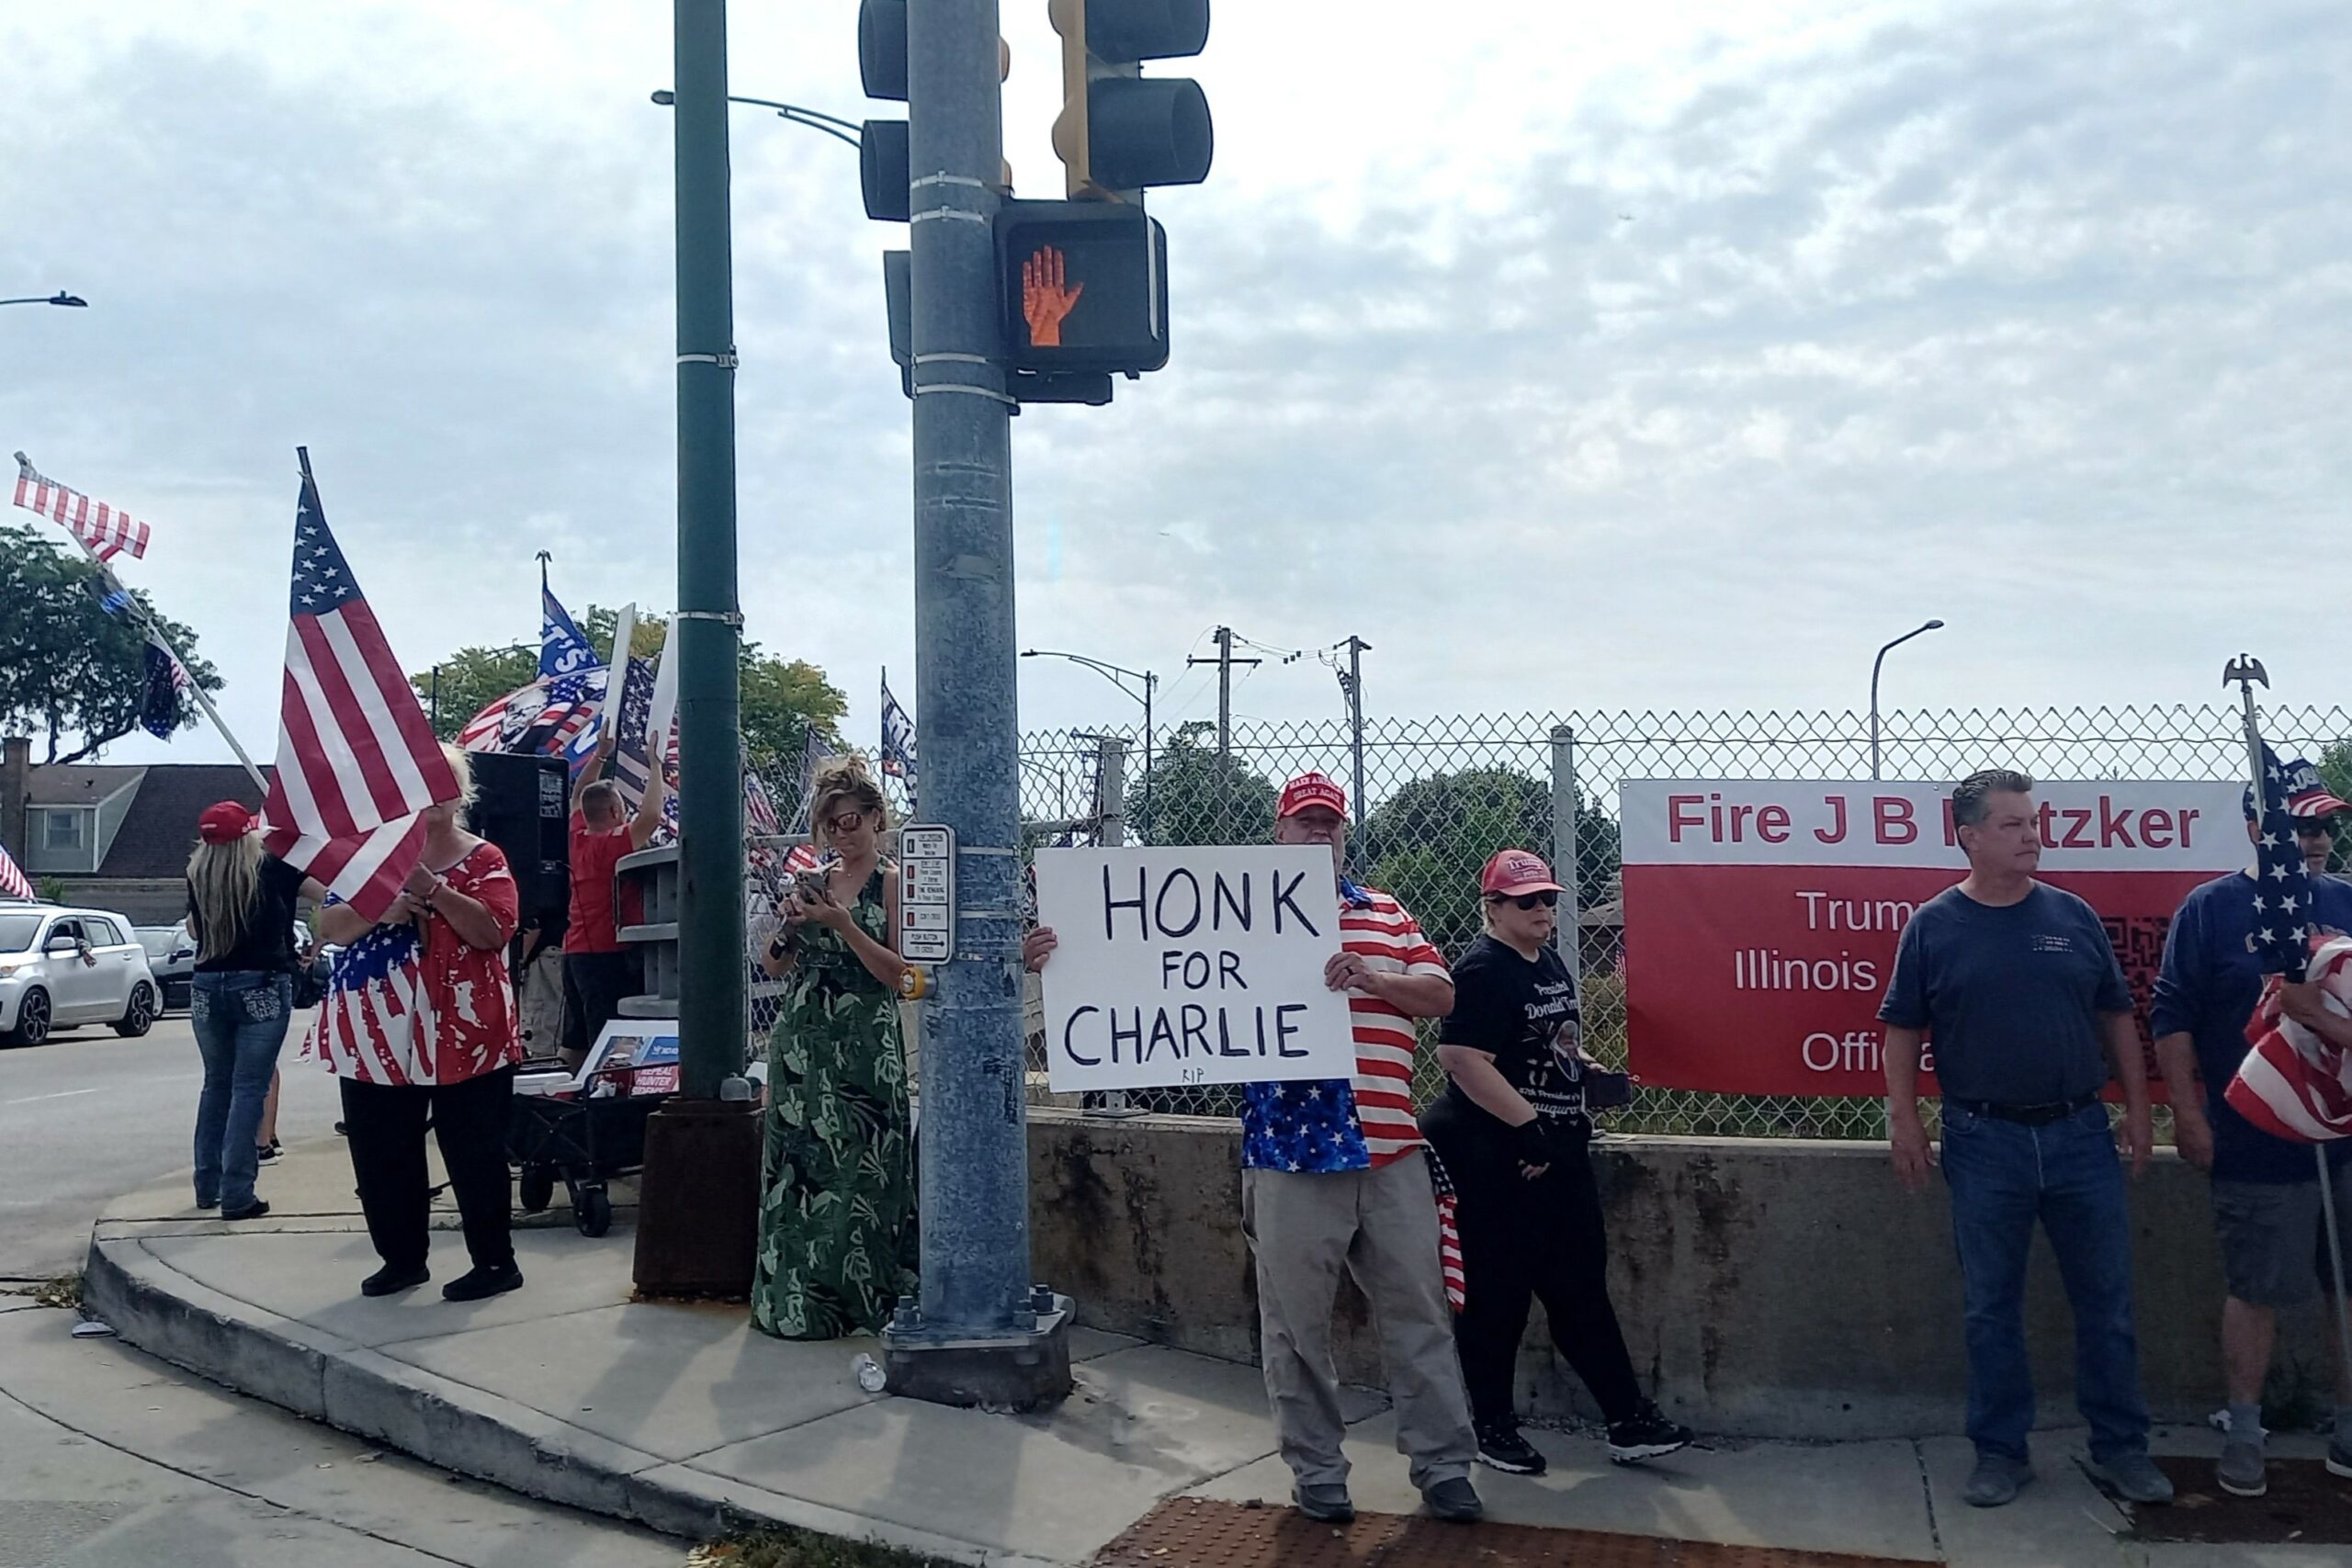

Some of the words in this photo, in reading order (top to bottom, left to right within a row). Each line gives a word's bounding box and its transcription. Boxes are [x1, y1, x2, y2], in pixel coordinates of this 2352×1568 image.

[1668, 792, 1792, 844] Fire
[1813, 795, 1849, 845] J
[1872, 795, 1918, 846] B
[1941, 795, 2200, 849] tzker
[1103, 864, 1320, 942] HONK
[1794, 890, 1926, 931] Trum
[1162, 950, 1249, 990] FOR
[1735, 949, 1877, 992] Illinois
[1524, 997, 1566, 1019] Donald
[1064, 1004, 1310, 1066] CHARLIE
[1182, 1067, 1204, 1084] RIP
